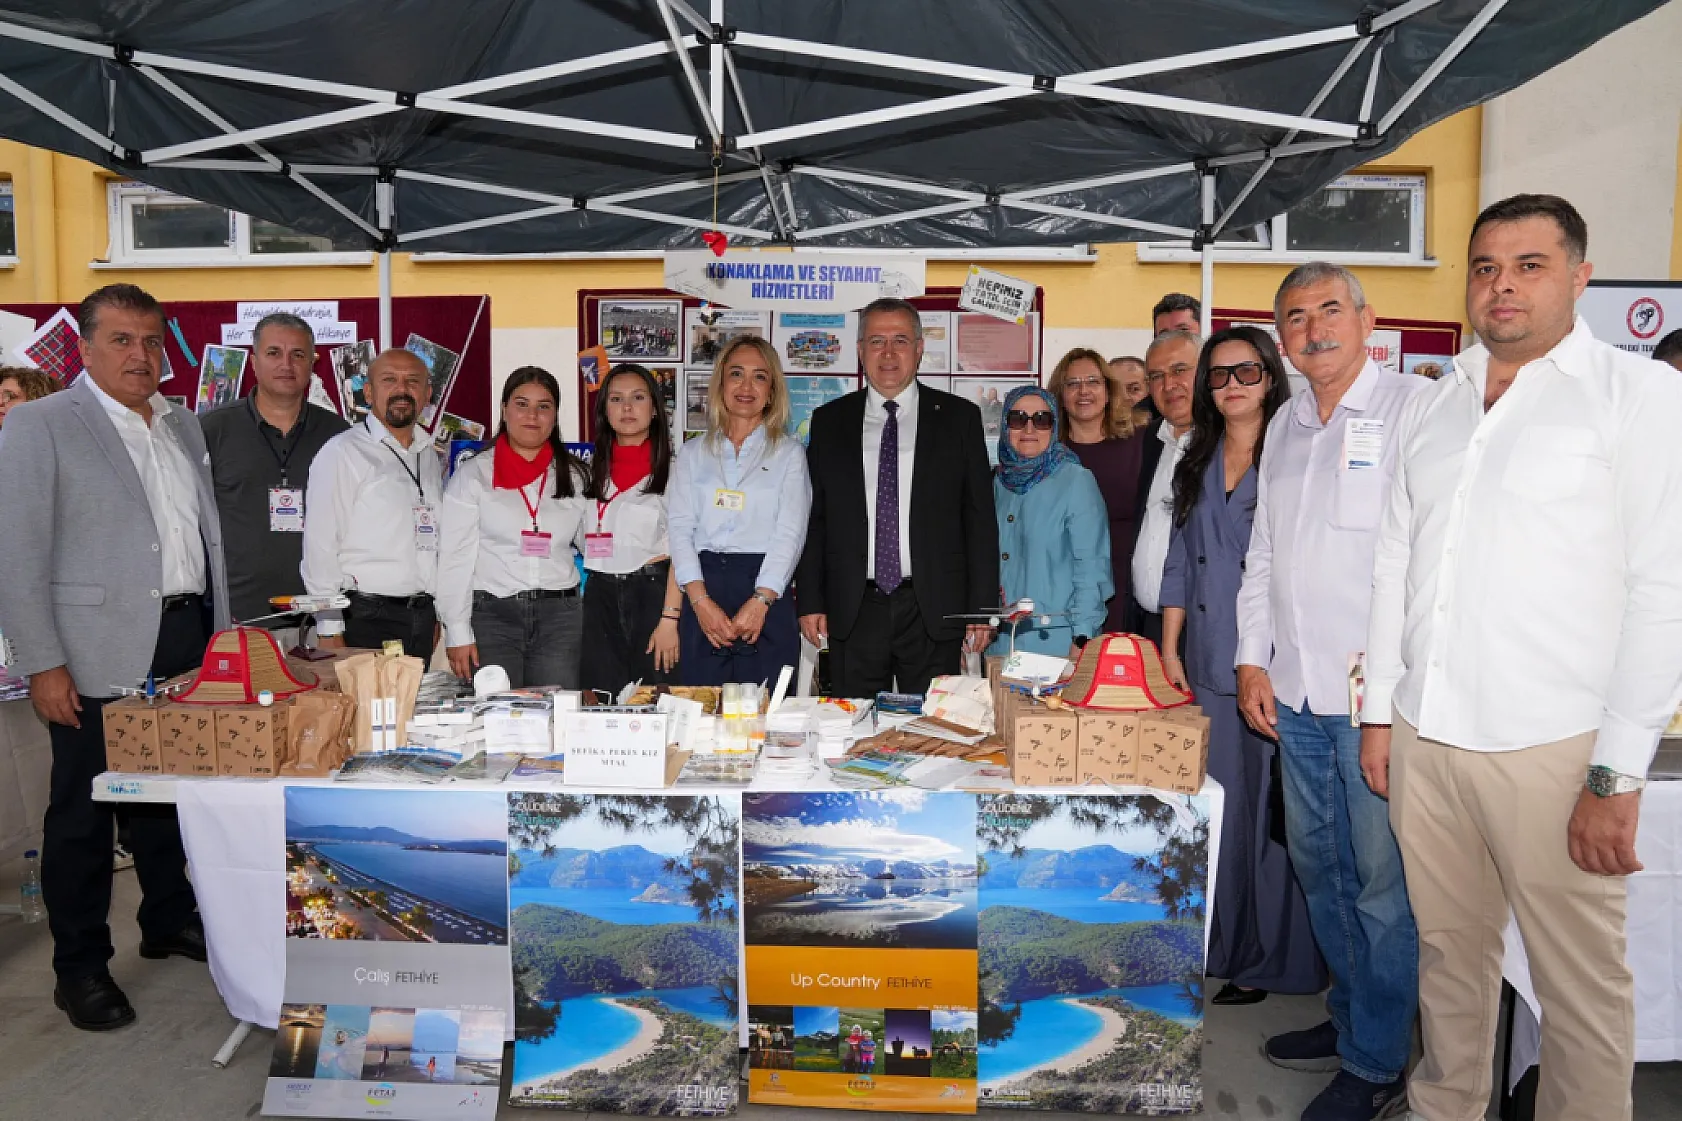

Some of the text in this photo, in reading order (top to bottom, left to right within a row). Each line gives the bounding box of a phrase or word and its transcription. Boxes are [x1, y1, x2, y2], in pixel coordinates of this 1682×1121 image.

[706, 262, 882, 284] KONAKLAMA VE SEYAHAT
[751, 280, 835, 300] HİZMETLERİ
[354, 966, 438, 986] Çalış FETHİYE
[790, 973, 932, 990] Up Country FETHİYE
